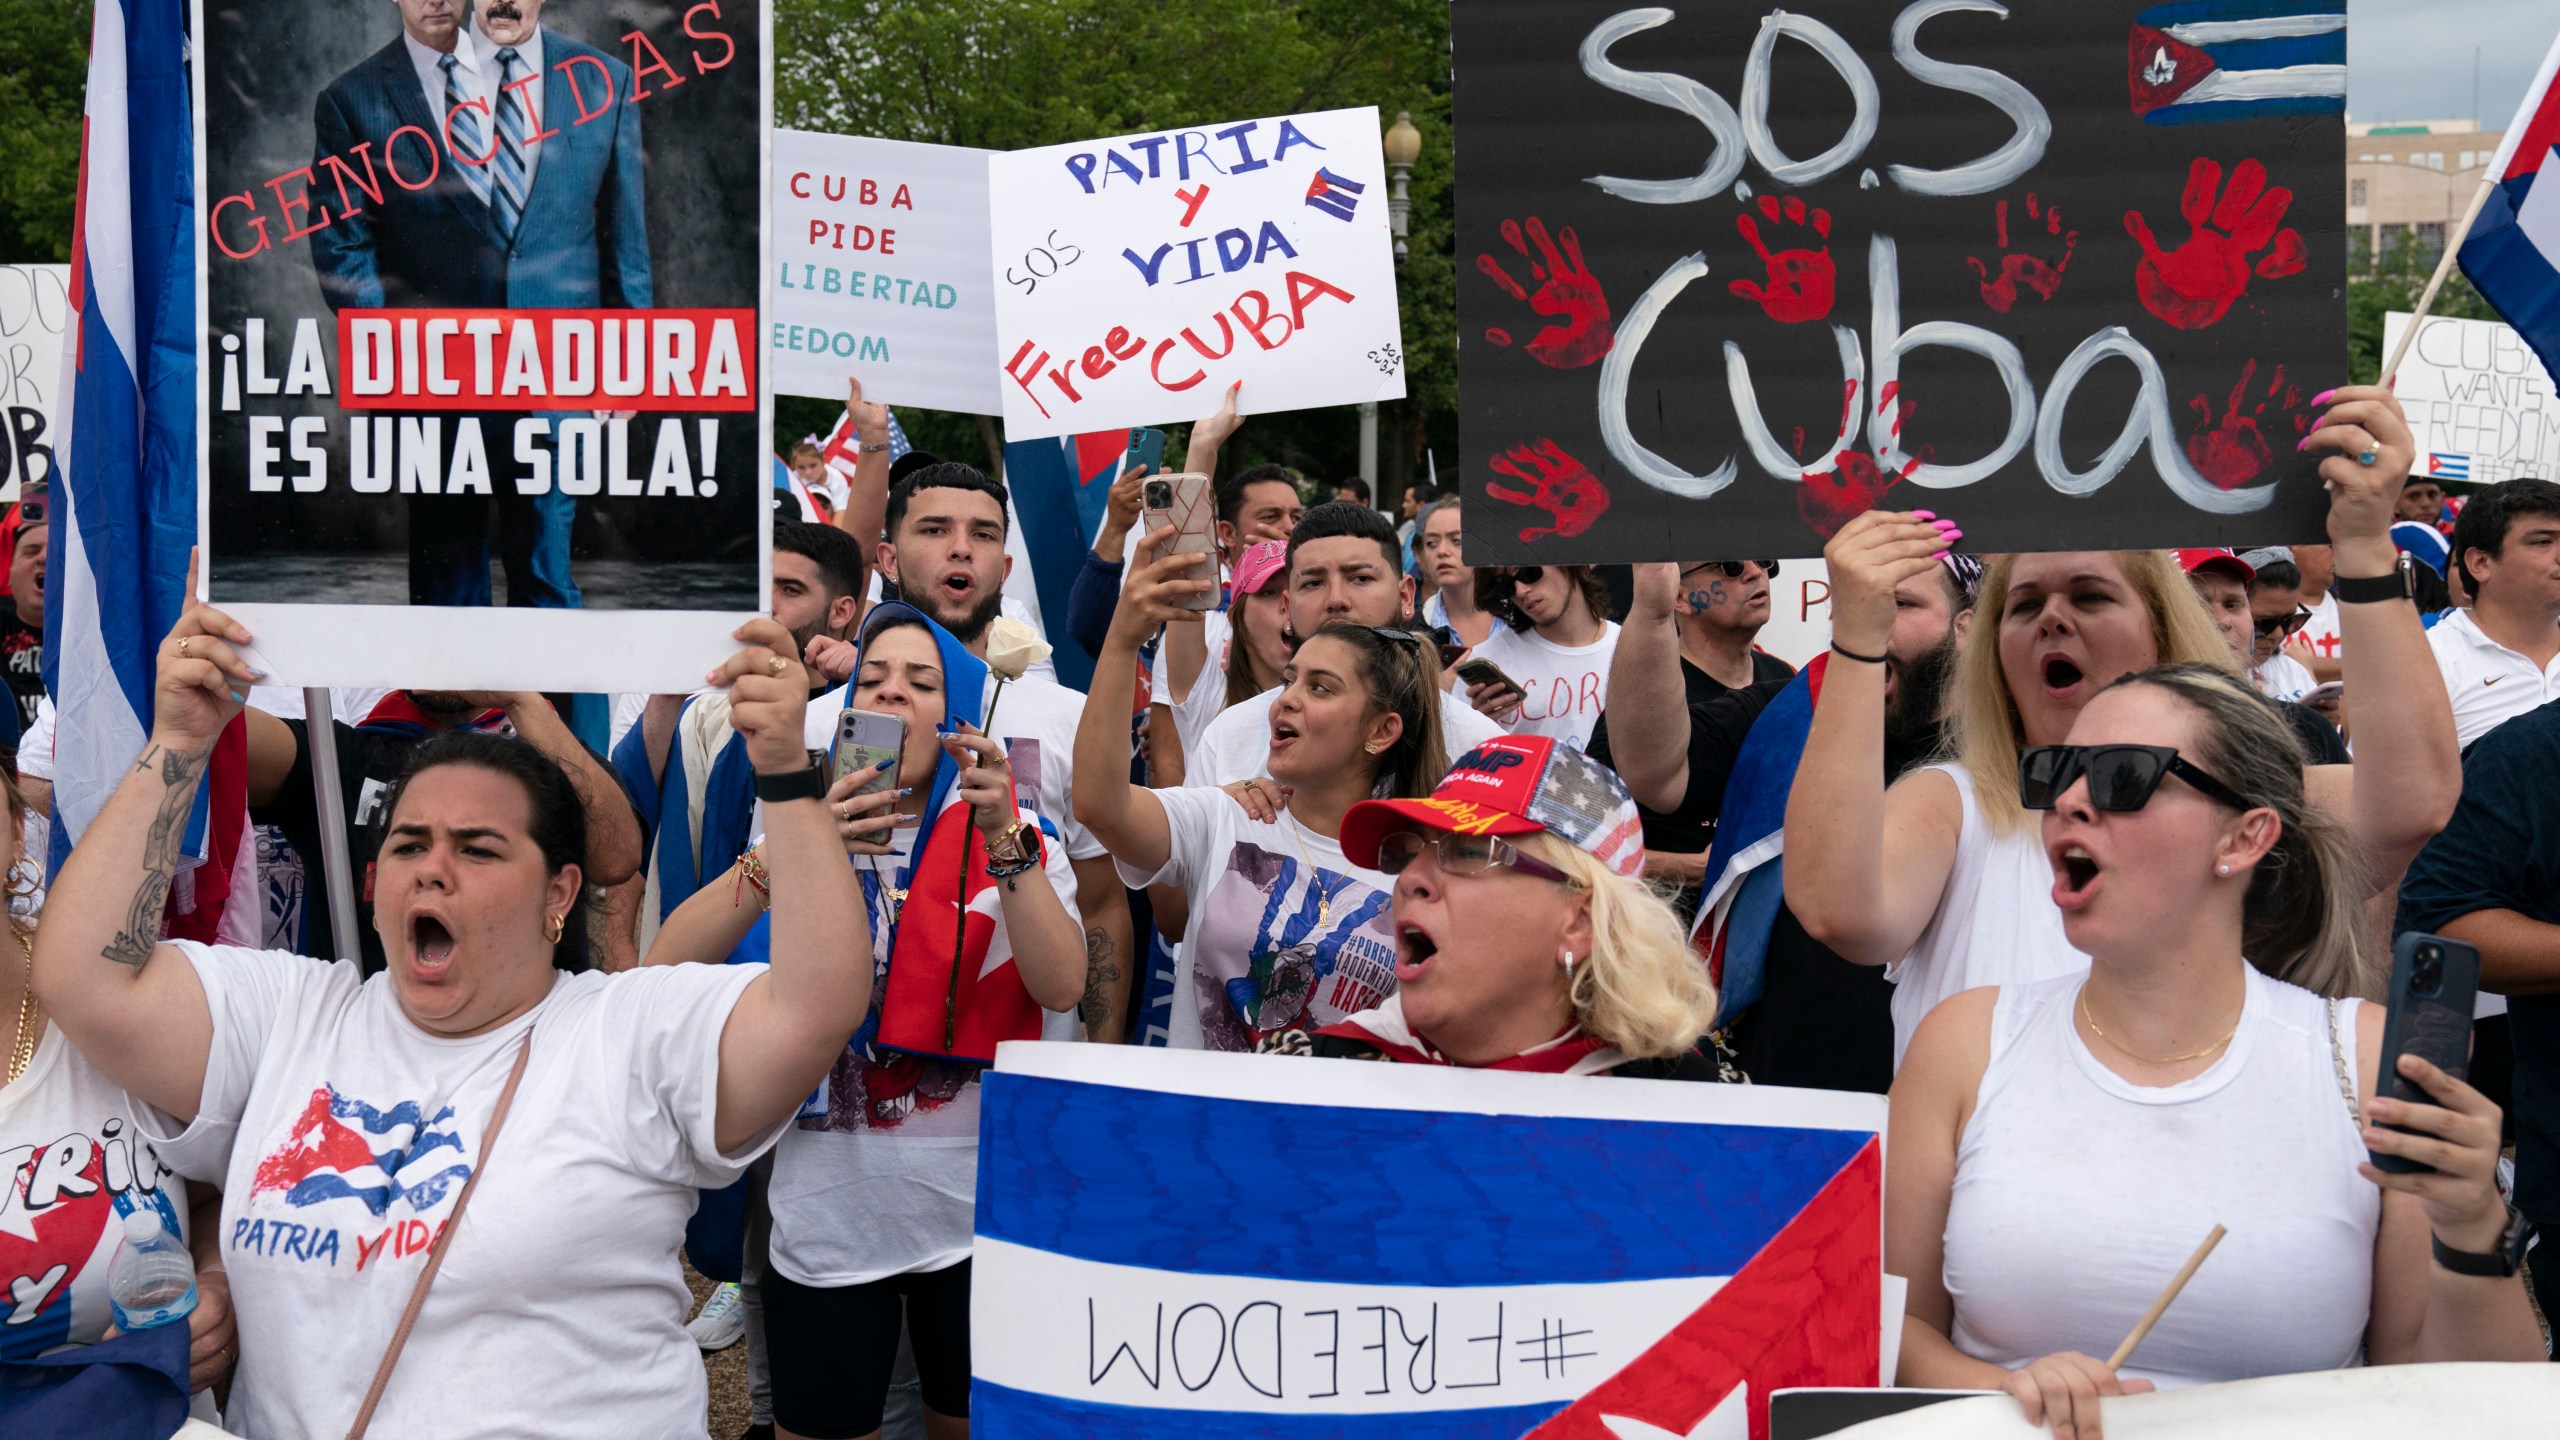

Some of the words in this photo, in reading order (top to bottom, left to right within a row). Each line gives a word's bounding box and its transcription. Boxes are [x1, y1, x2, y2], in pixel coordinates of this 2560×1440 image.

[210, 3, 735, 259] GENOCIDAS
[1065, 119, 1326, 194] PATRIA
[790, 172, 913, 211] CUBA
[1174, 183, 1209, 227] Y
[809, 219, 896, 255] PIDE
[1122, 220, 1298, 286] VIDA
[780, 262, 957, 309] LIBERTAD
[222, 317, 330, 411] ¡LA
[351, 317, 748, 398] DICTADURA
[1005, 325, 1147, 419] Free
[1151, 271, 1356, 392] CUBA
[1367, 350, 1395, 377] CUBA
[1599, 232, 2278, 515] Cuba
[2442, 370, 2543, 411] WANTS
[249, 417, 327, 493] ES
[350, 417, 493, 494] UNA
[513, 418, 719, 497] SOLA!
[1465, 773, 1503, 788] AGAIN
[232, 1217, 340, 1267] PATRIA
[6, 1263, 69, 1325] Y
[1089, 1296, 1599, 1400] #FREEDOM
